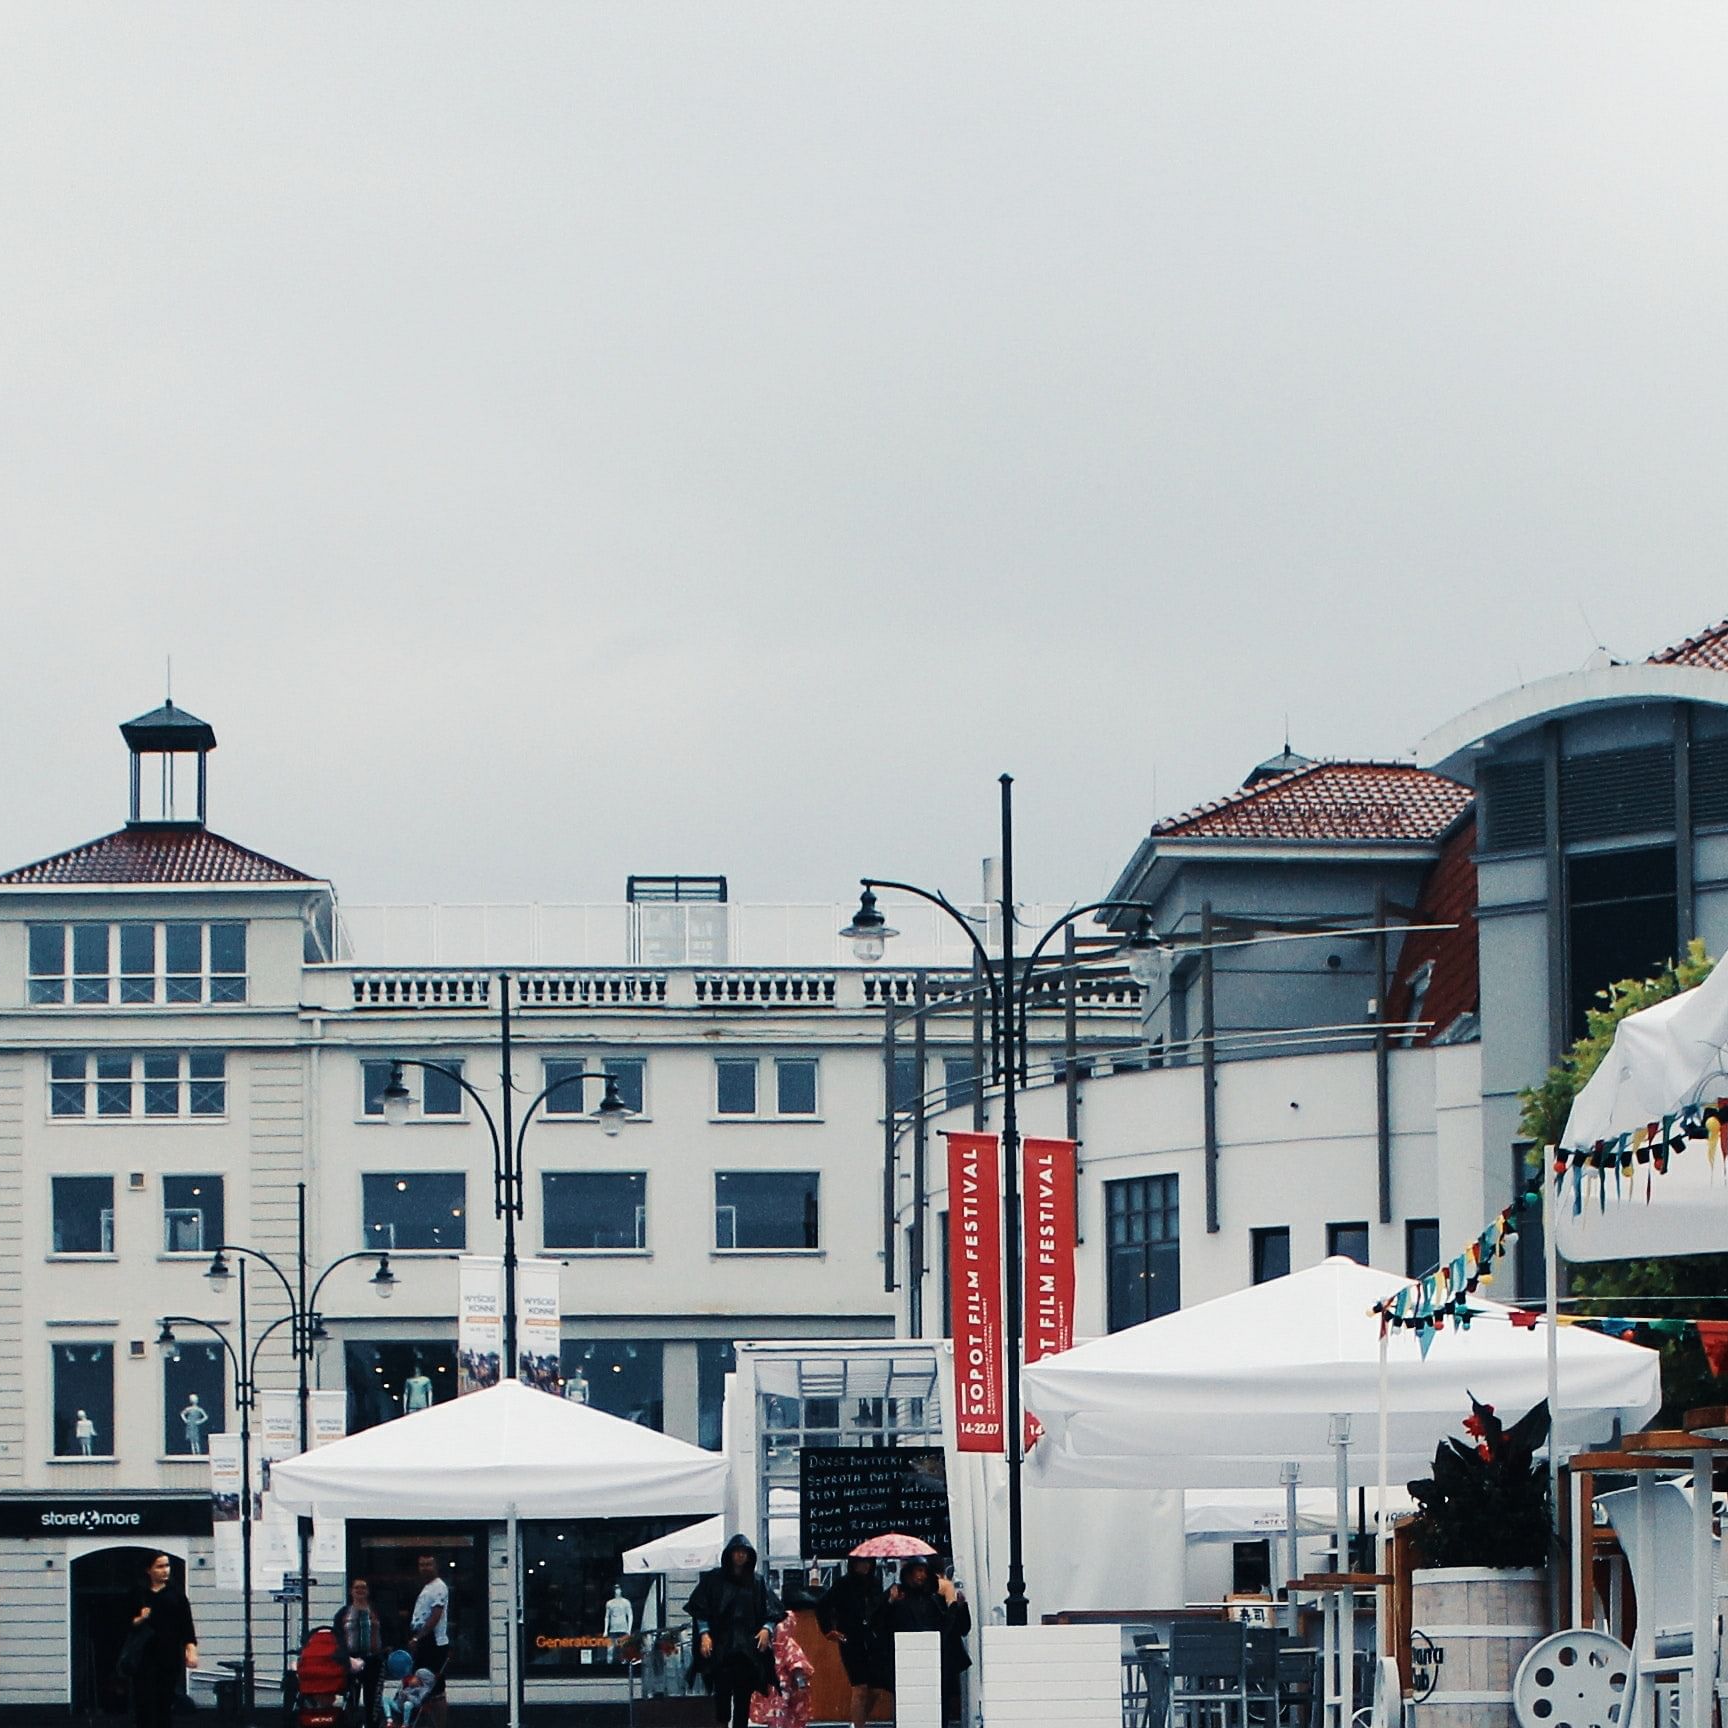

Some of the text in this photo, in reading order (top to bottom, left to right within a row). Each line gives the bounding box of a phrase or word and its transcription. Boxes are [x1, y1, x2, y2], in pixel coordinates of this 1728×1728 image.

[1038, 1154, 1055, 1264] FESTIVAL
[963, 1148, 984, 1415] SOPOT FILM FESTIVAL
[1039, 1275, 1056, 1328] FILM
[960, 1422, 1000, 1435] 14-22.07
